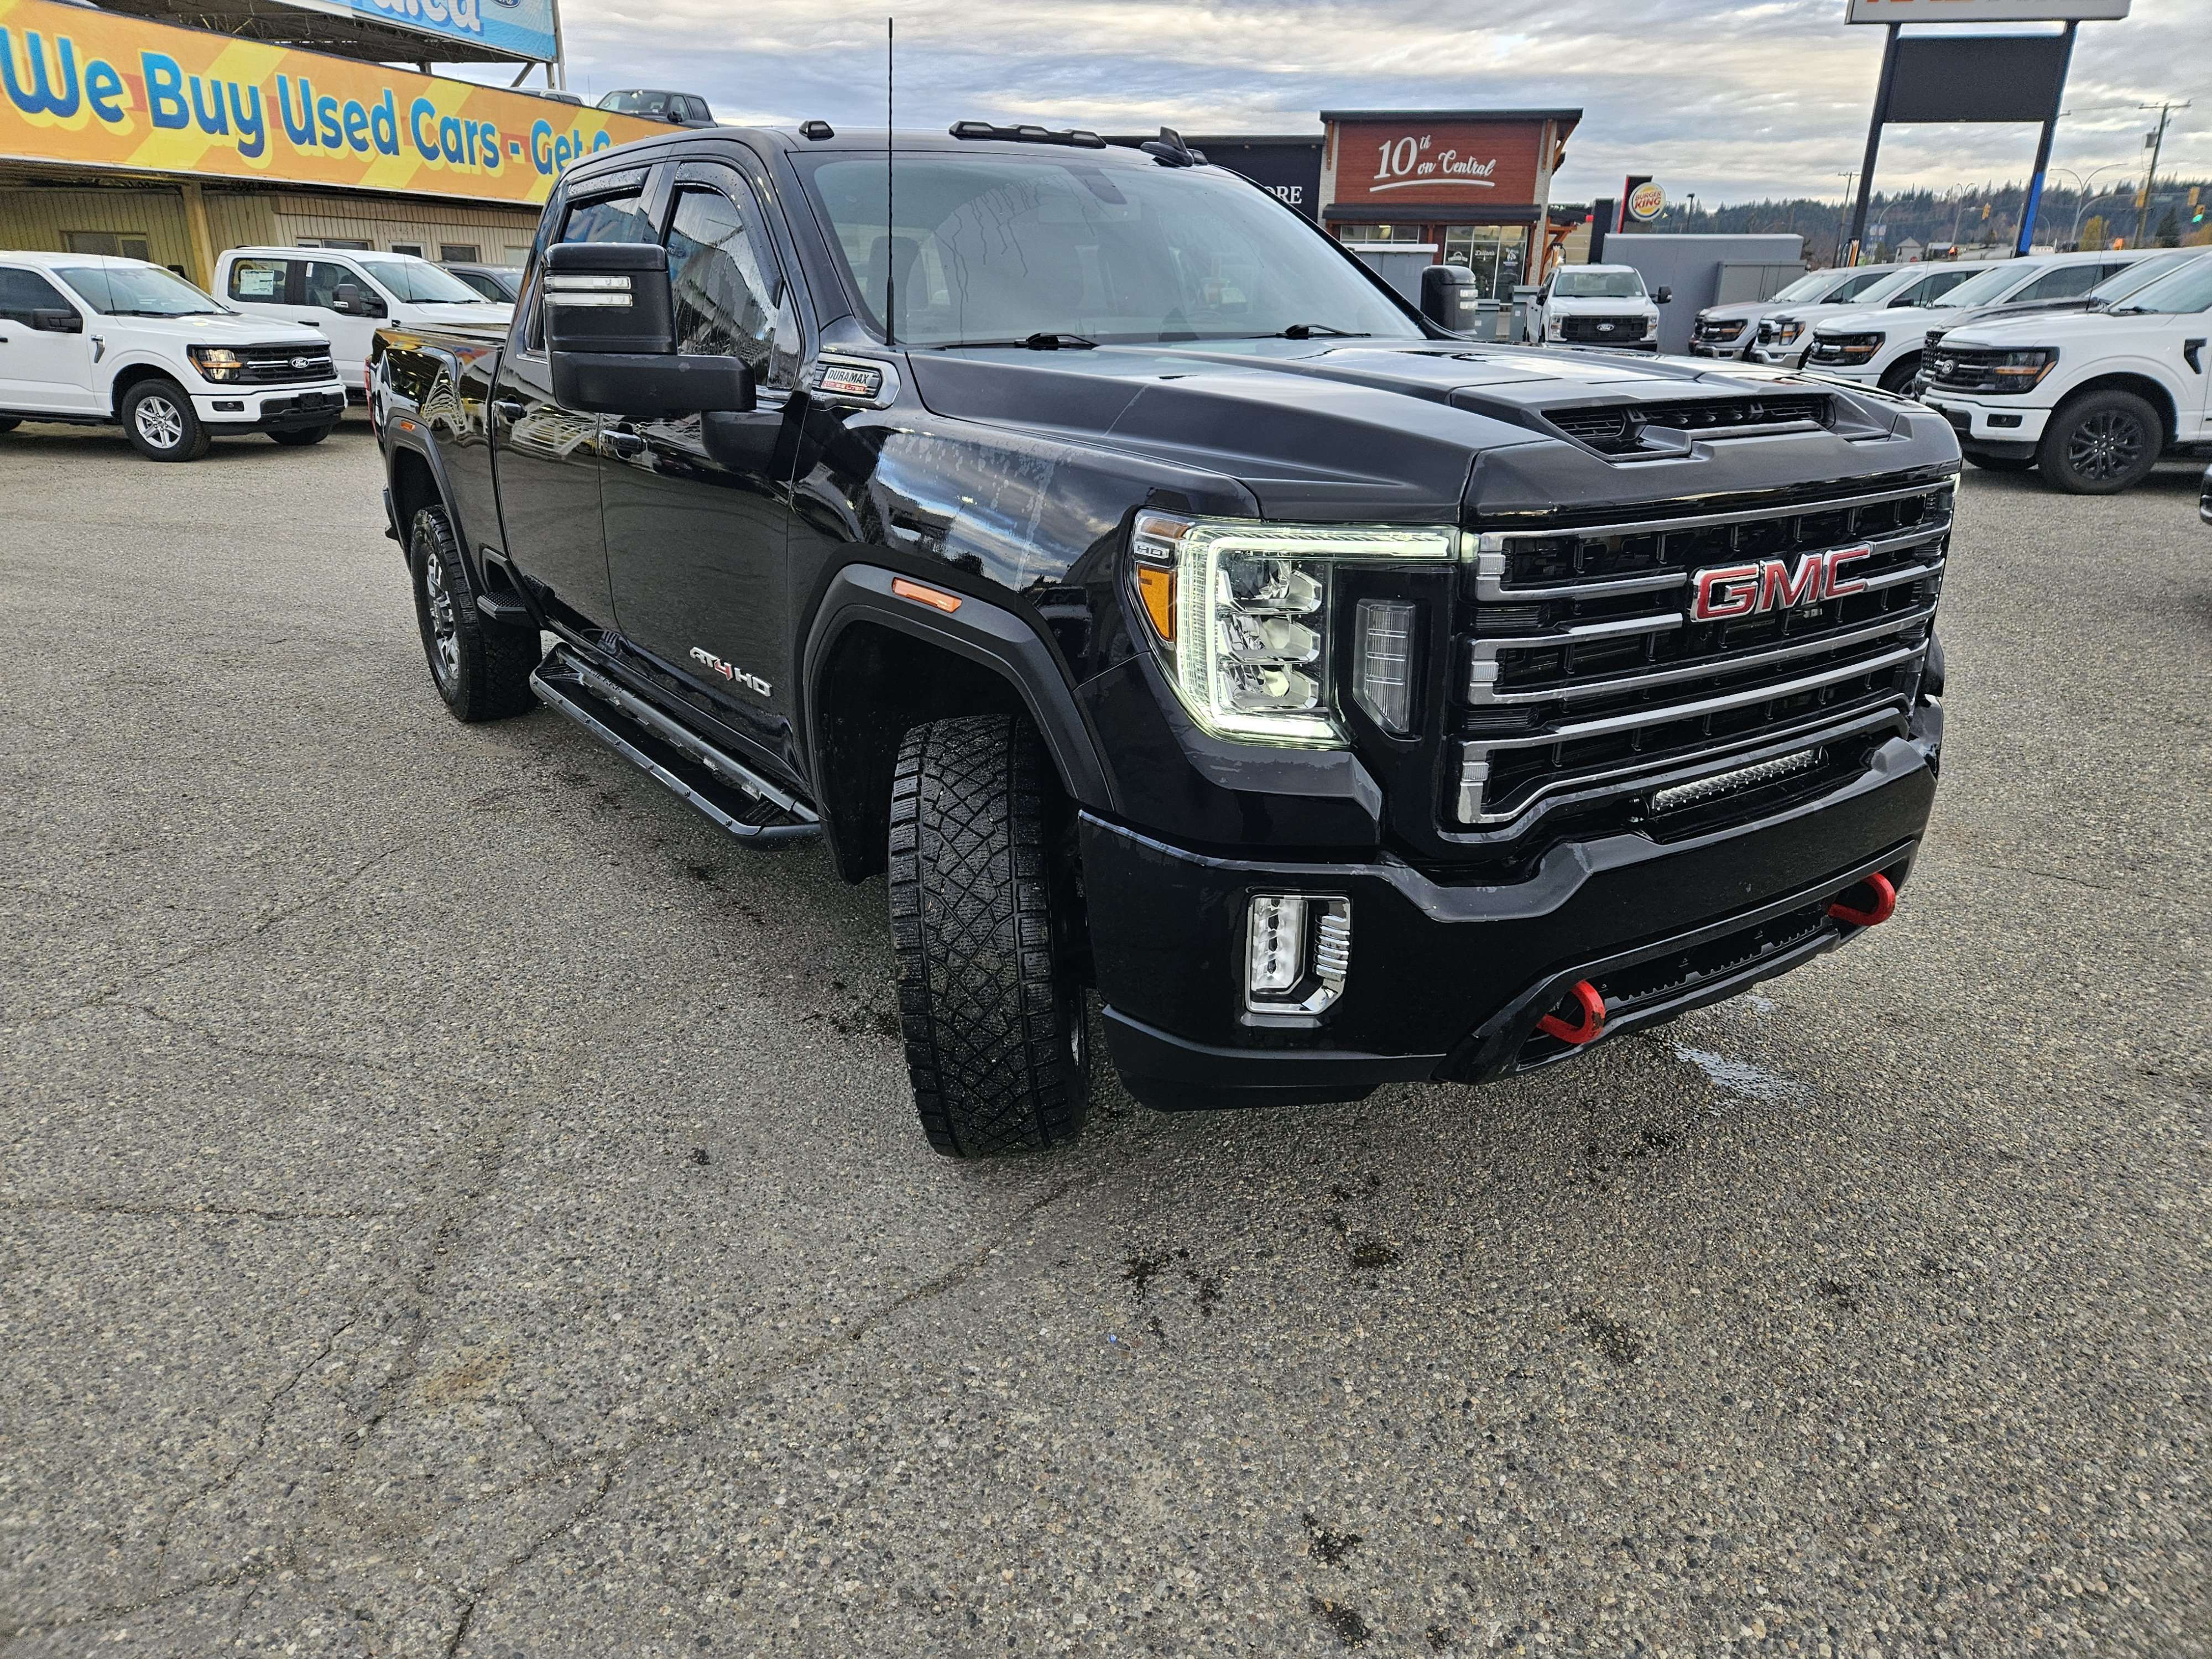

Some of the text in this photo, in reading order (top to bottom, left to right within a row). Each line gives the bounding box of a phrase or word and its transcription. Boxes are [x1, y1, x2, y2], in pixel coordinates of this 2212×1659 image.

[0, 26, 125, 123] We
[142, 51, 265, 158] Buy
[276, 74, 399, 155] Used
[411, 98, 499, 168] Cars
[531, 119, 583, 175] Get
[1417, 161, 1436, 175] on
[1438, 150, 1496, 176] Central
[1635, 191, 1661, 200] BURGER
[1635, 197, 1661, 210] KING
[828, 369, 869, 384] DURAMAX
[1137, 545, 1163, 556] HD
[1691, 542, 1870, 623] GMC
